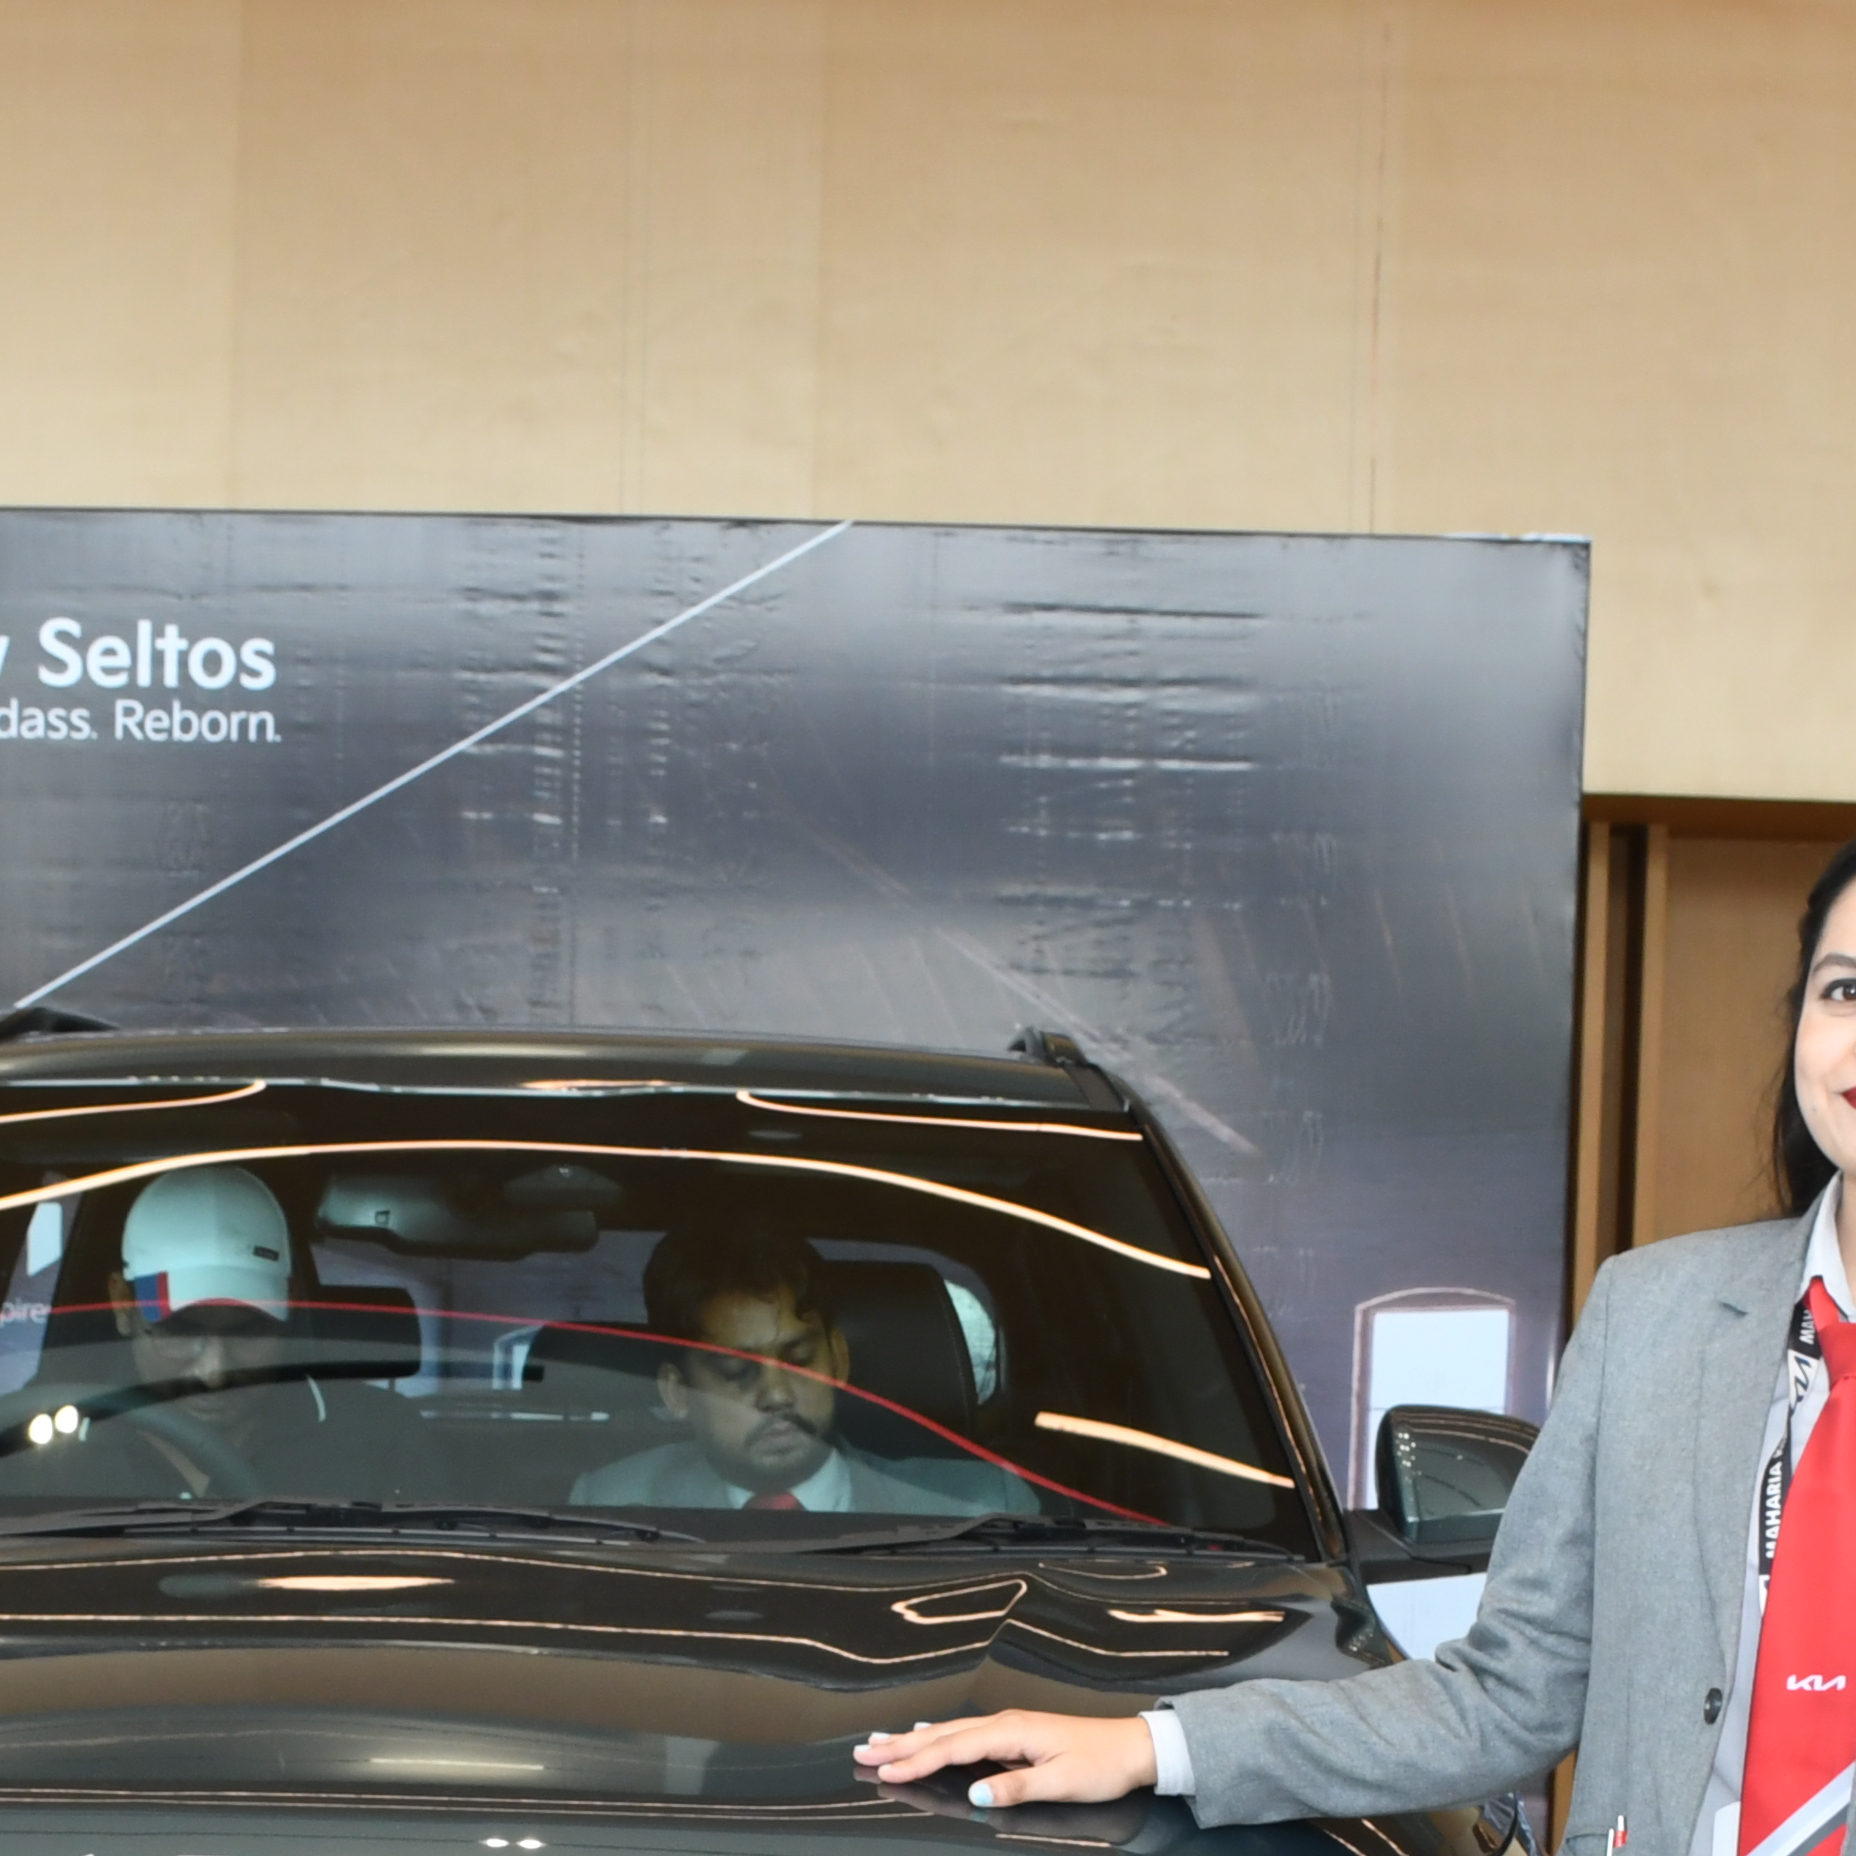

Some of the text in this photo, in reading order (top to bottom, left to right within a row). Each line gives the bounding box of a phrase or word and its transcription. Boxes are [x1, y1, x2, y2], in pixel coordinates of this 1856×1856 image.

[38, 616, 277, 691] Seltos
[114, 697, 282, 743] Reborn.
[1786, 1674, 1847, 1692] KIA
